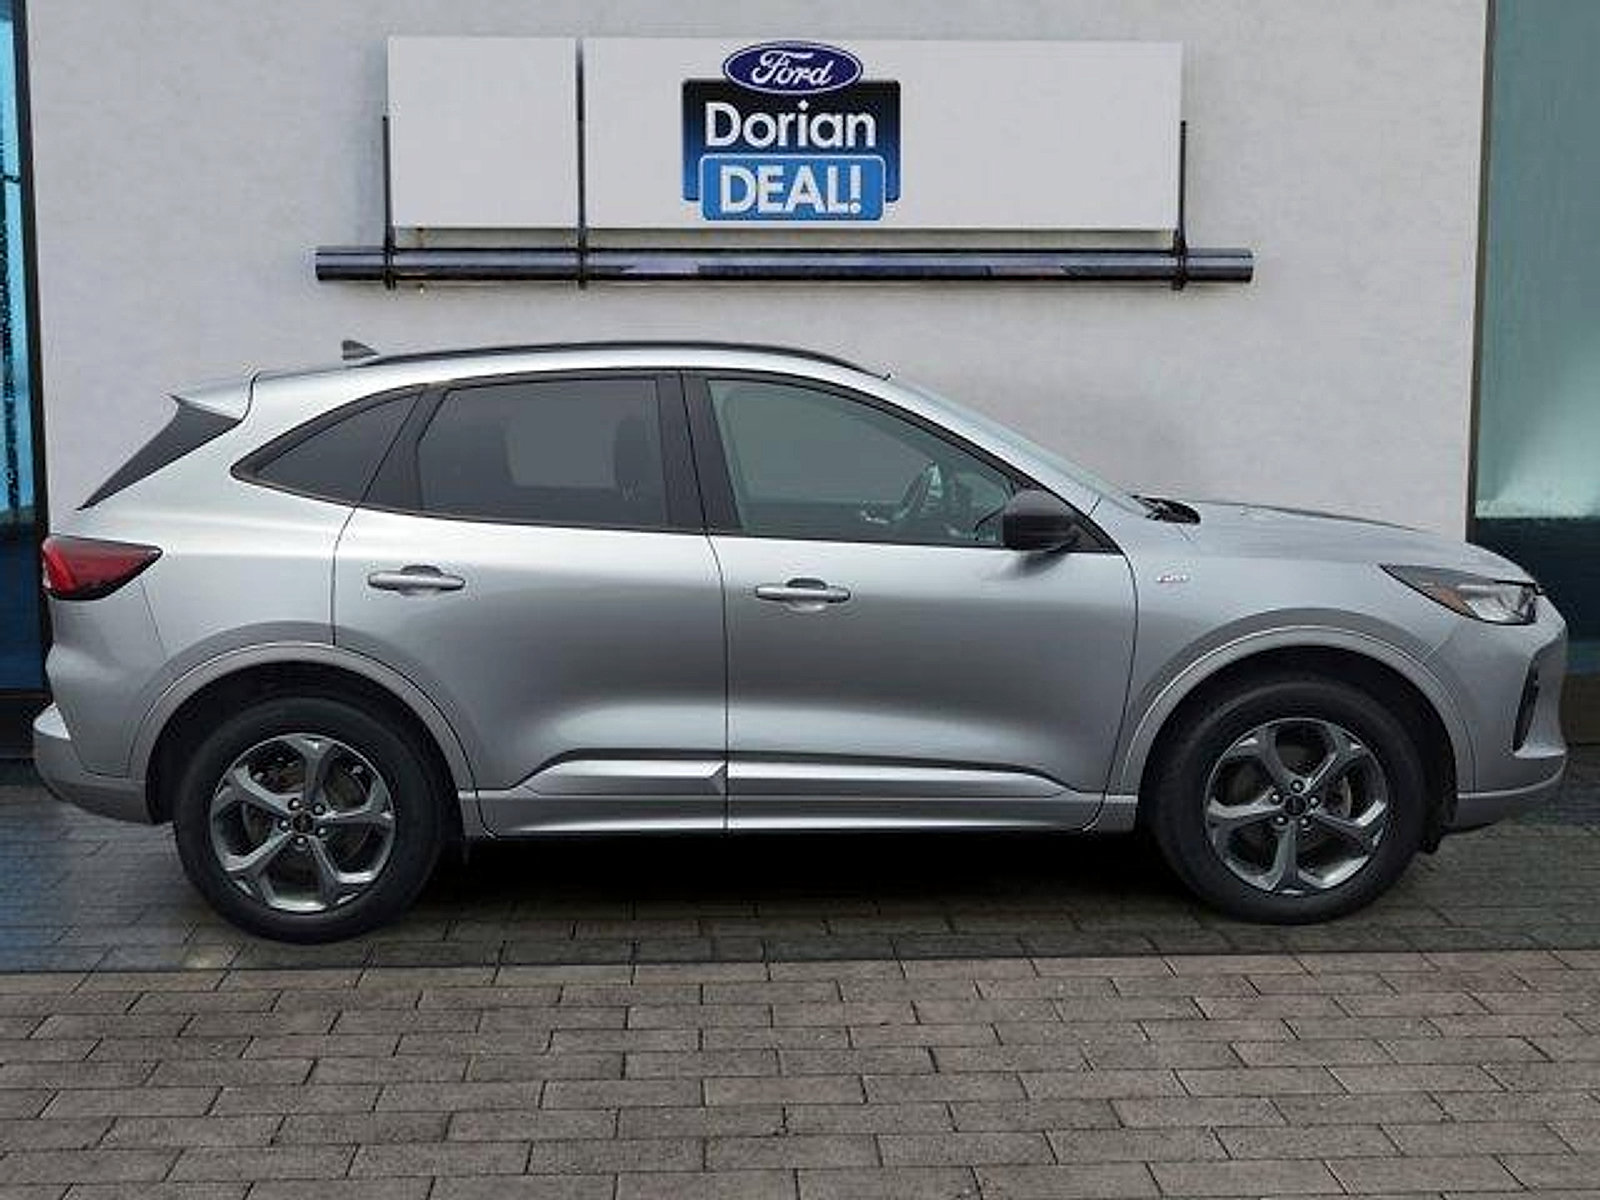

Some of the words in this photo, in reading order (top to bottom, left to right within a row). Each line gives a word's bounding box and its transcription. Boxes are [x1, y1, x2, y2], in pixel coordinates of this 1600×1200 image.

[752, 50, 834, 85] Ford
[705, 100, 876, 148] Dorian
[720, 165, 862, 214] DEAL!
